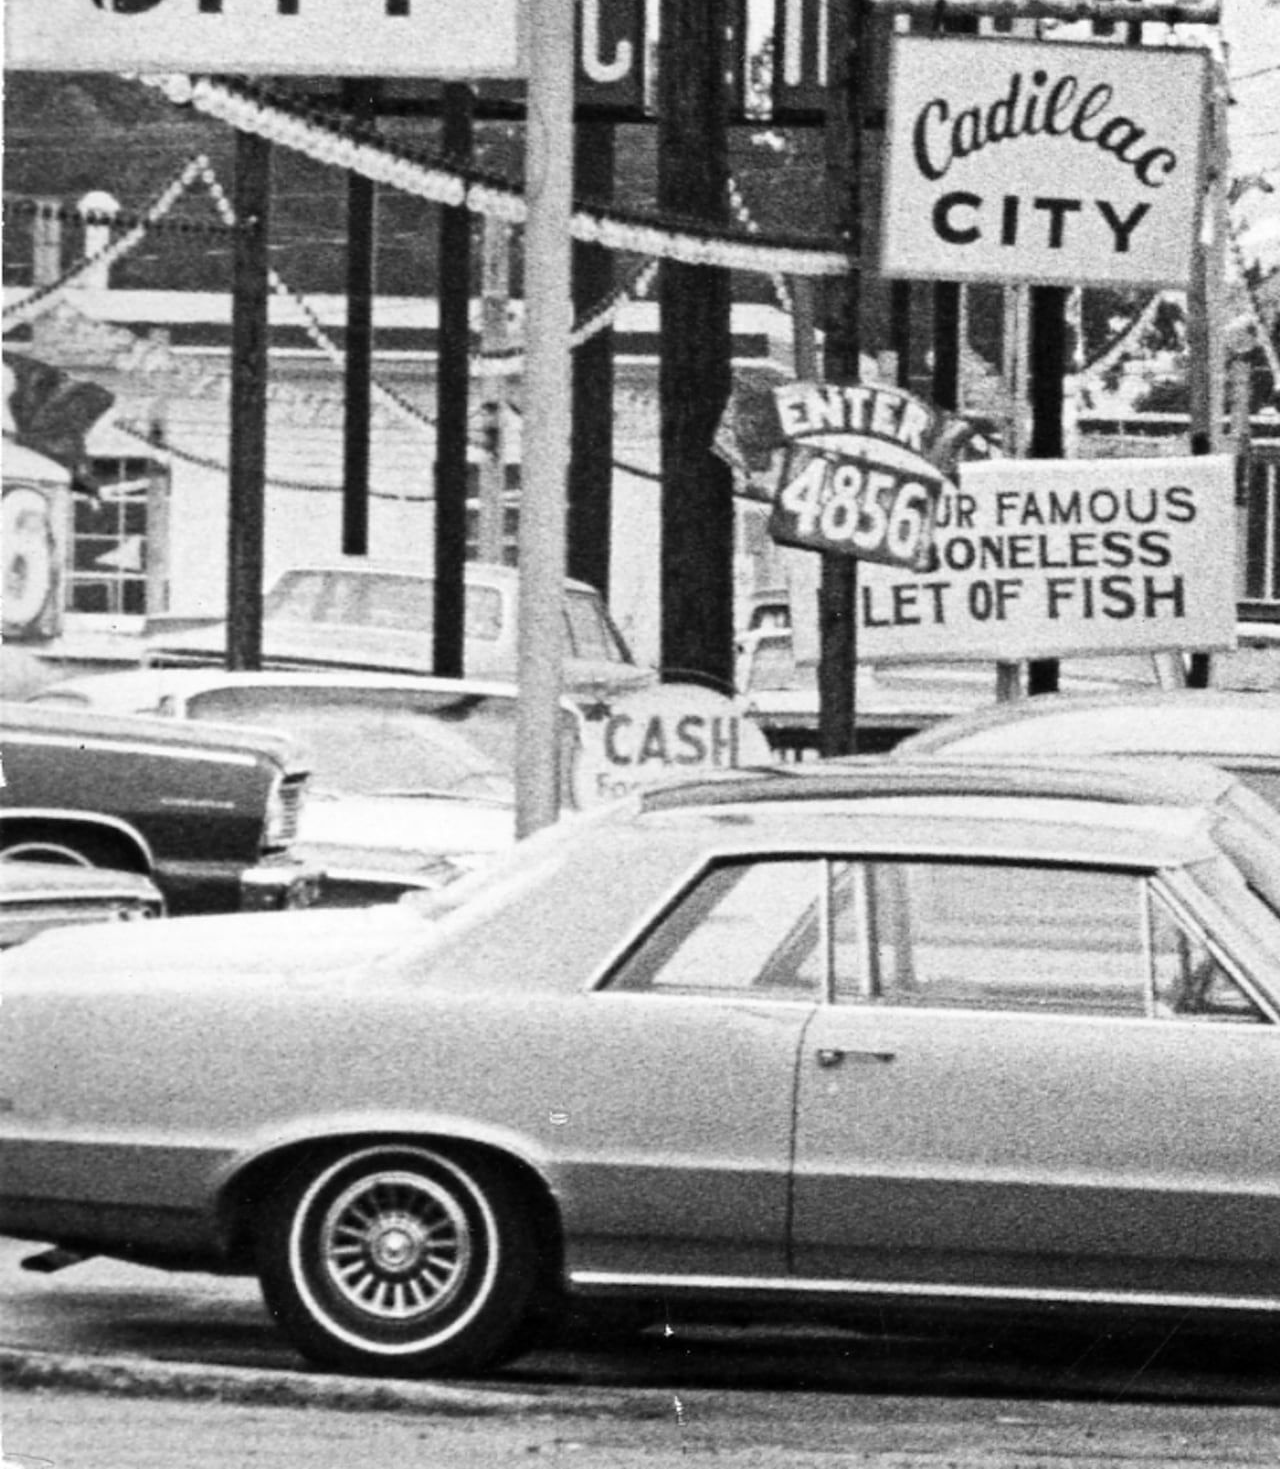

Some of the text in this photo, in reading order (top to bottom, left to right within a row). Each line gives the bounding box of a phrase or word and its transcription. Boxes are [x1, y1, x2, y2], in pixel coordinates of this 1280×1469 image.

[912, 69, 1178, 189] Cadillac
[931, 190, 1152, 253] CITY
[774, 384, 930, 452] ENTER
[781, 456, 927, 560] 4856
[934, 486, 1197, 528] UR FAMOUS
[862, 574, 1187, 628] LET OF FISH
[604, 713, 741, 770] CASH
